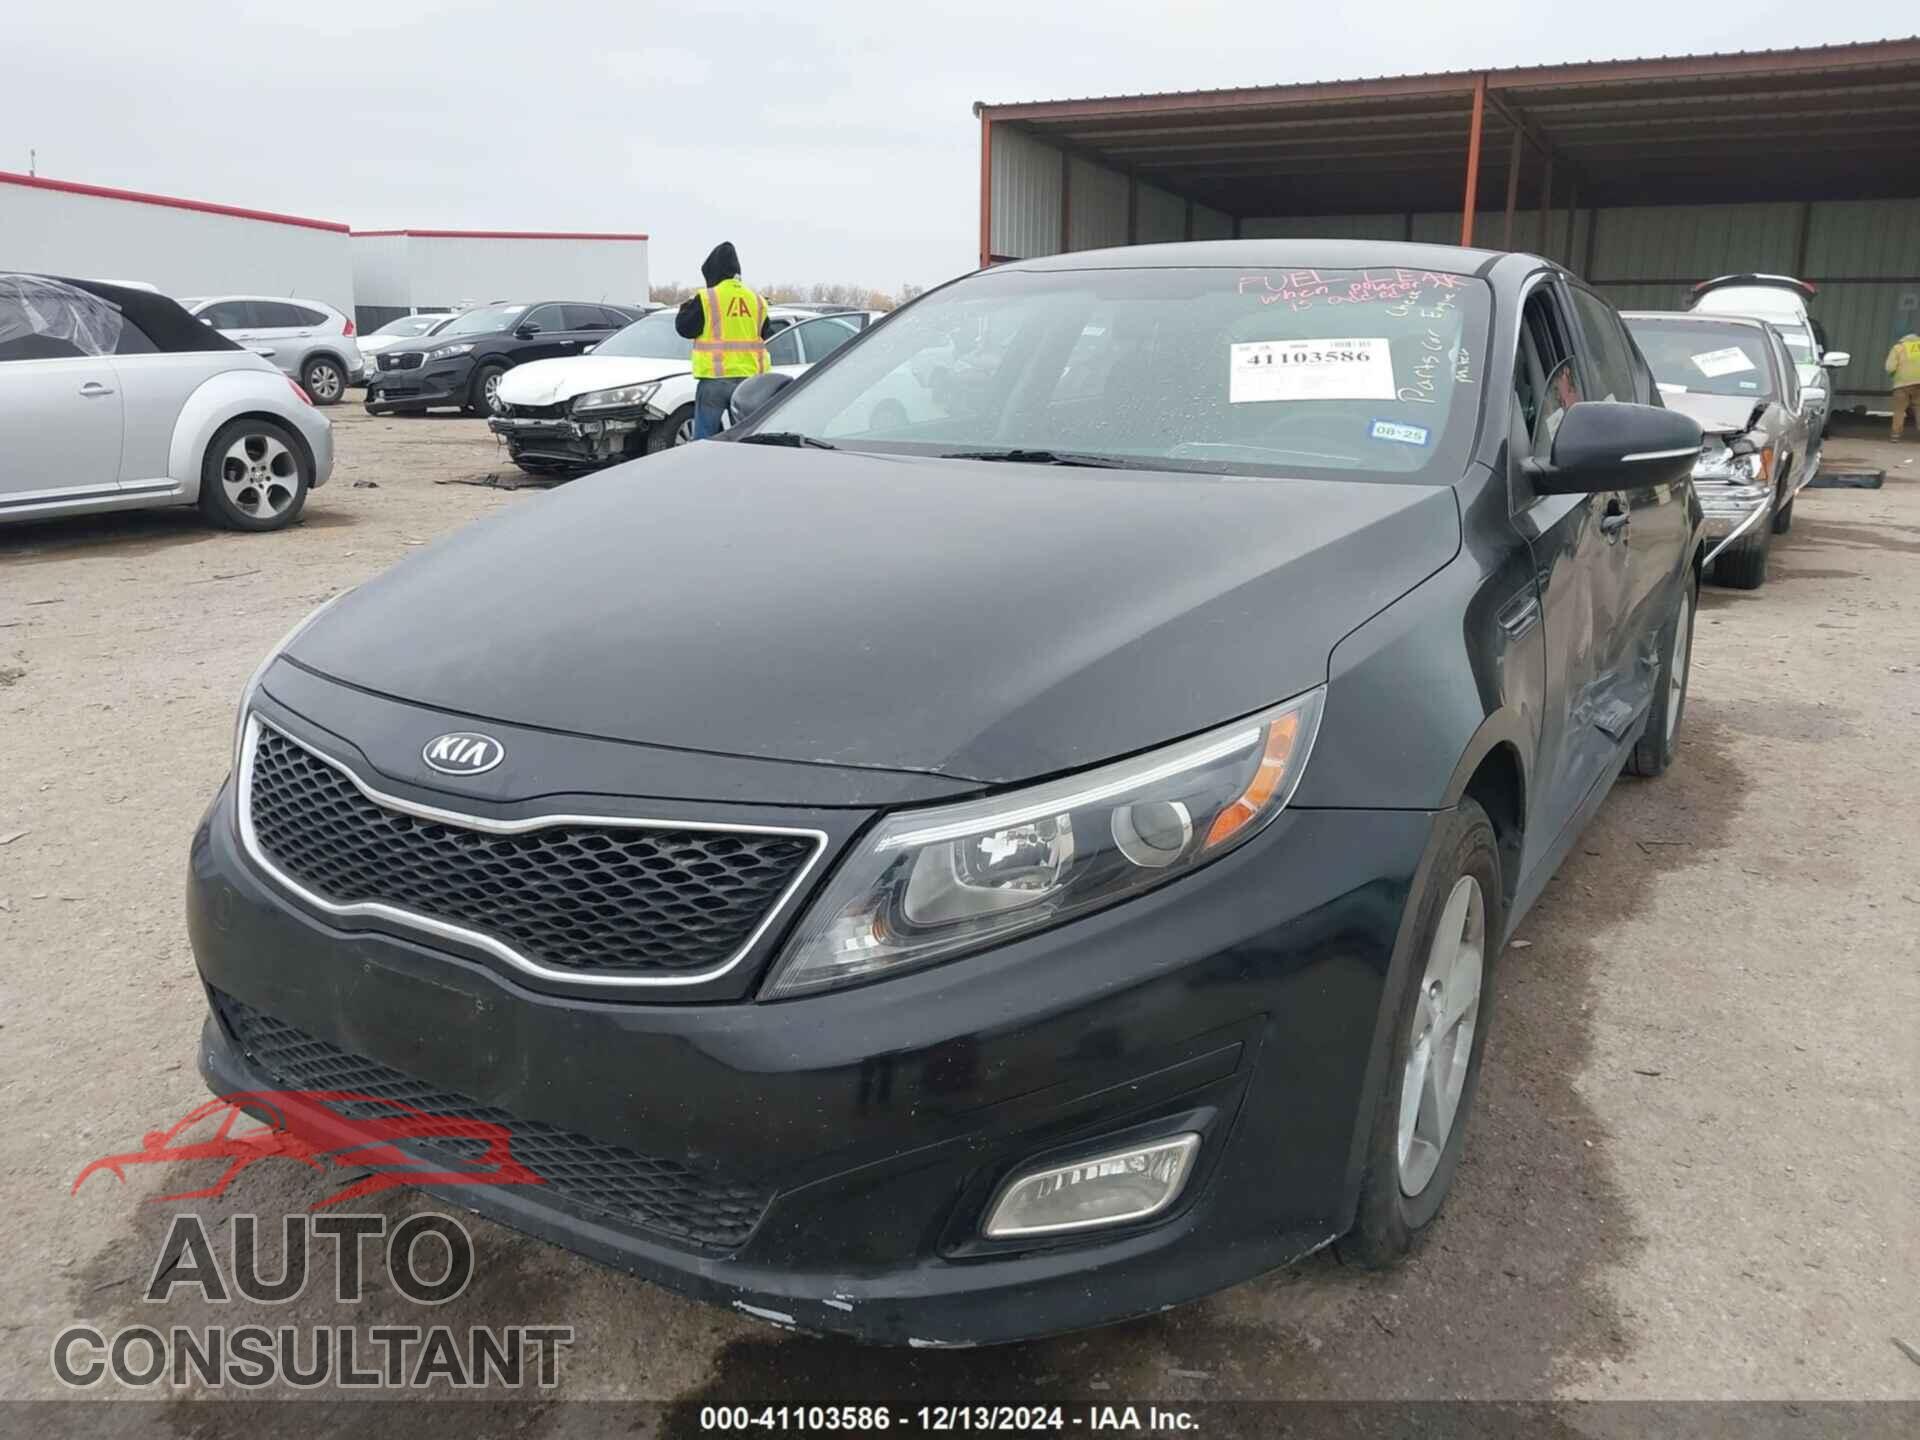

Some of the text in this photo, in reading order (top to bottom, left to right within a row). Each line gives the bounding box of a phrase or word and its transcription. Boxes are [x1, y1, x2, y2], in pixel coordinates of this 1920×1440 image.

[1238, 270, 1346, 294] FUEL
[1247, 351, 1371, 366] 41103586
[430, 736, 489, 767] KIA
